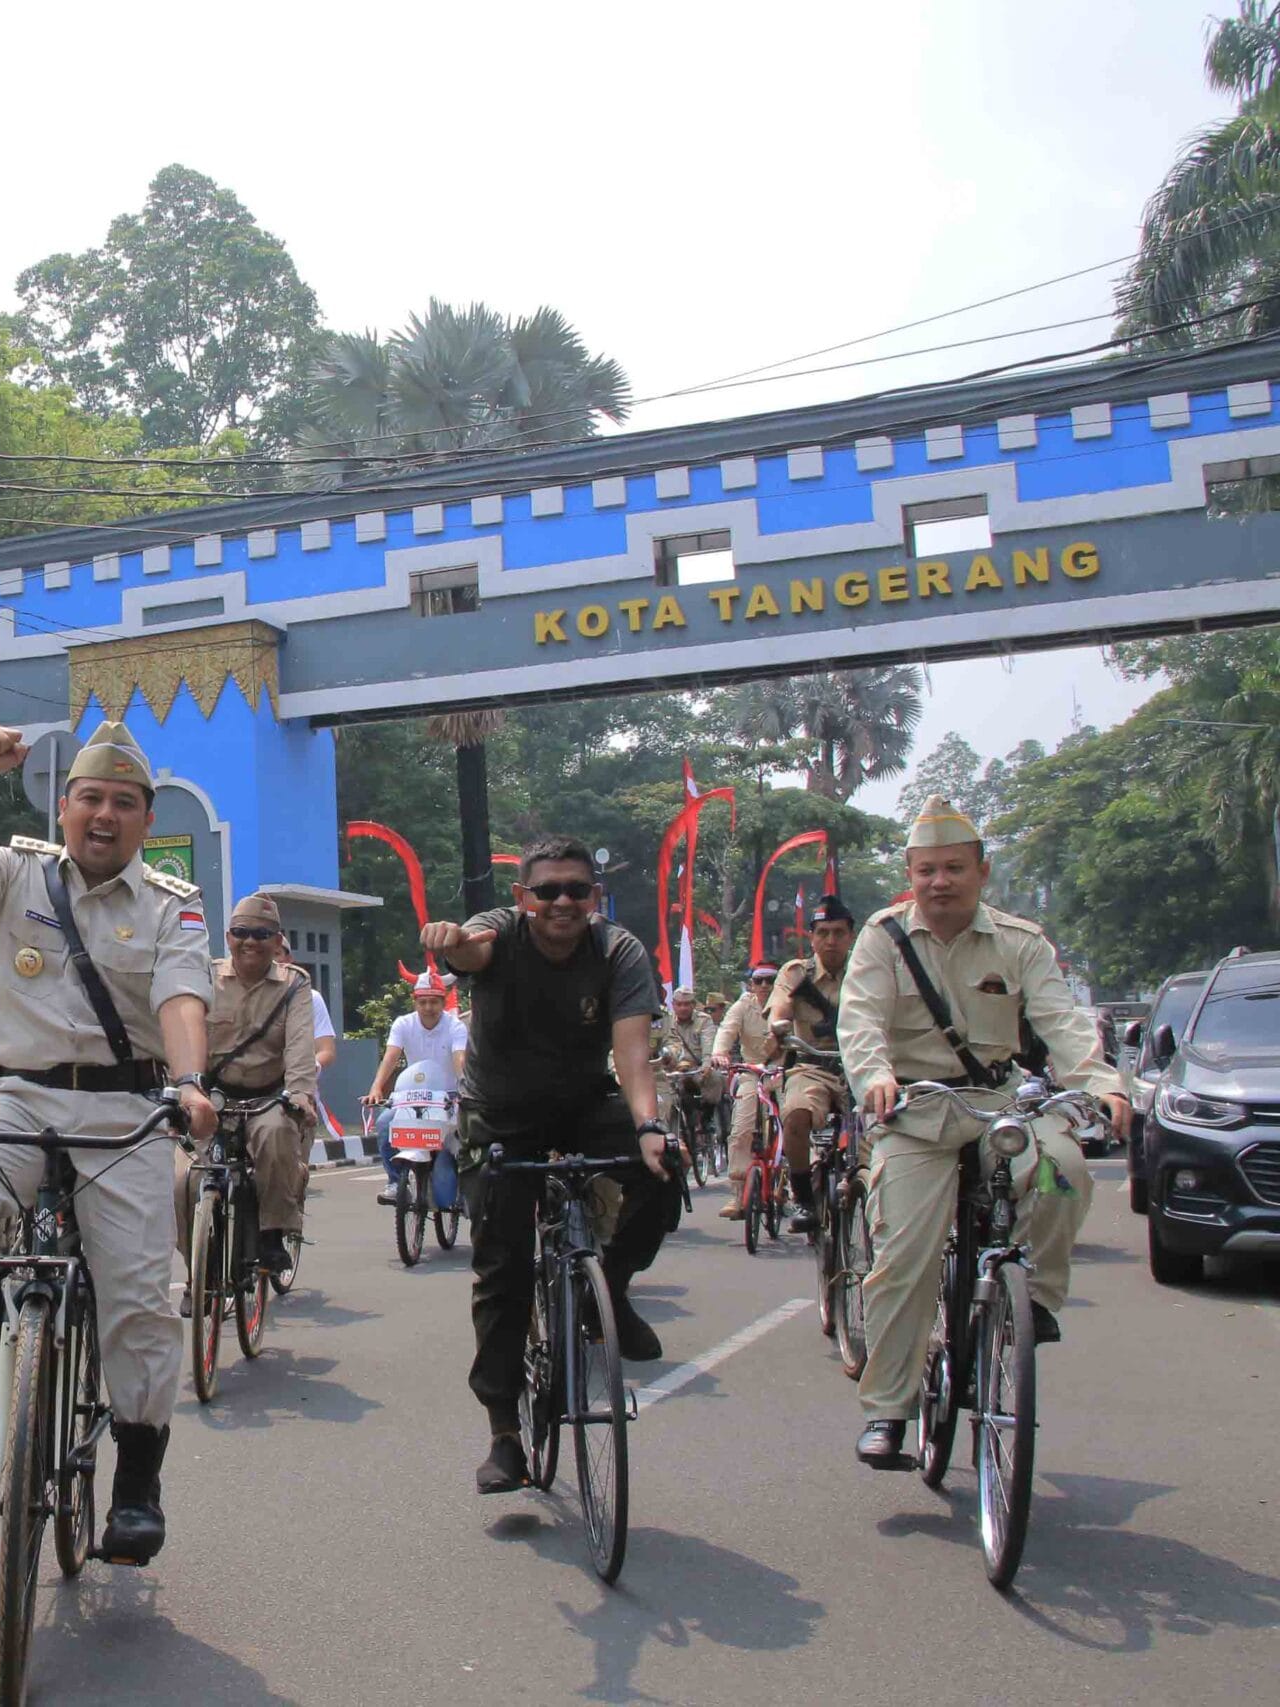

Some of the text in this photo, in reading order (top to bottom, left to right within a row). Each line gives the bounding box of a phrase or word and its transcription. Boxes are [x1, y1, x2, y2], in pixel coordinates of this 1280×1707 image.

[534, 542, 1100, 644] KOTA TANGERANG
[407, 1091, 433, 1101] DISHUB
